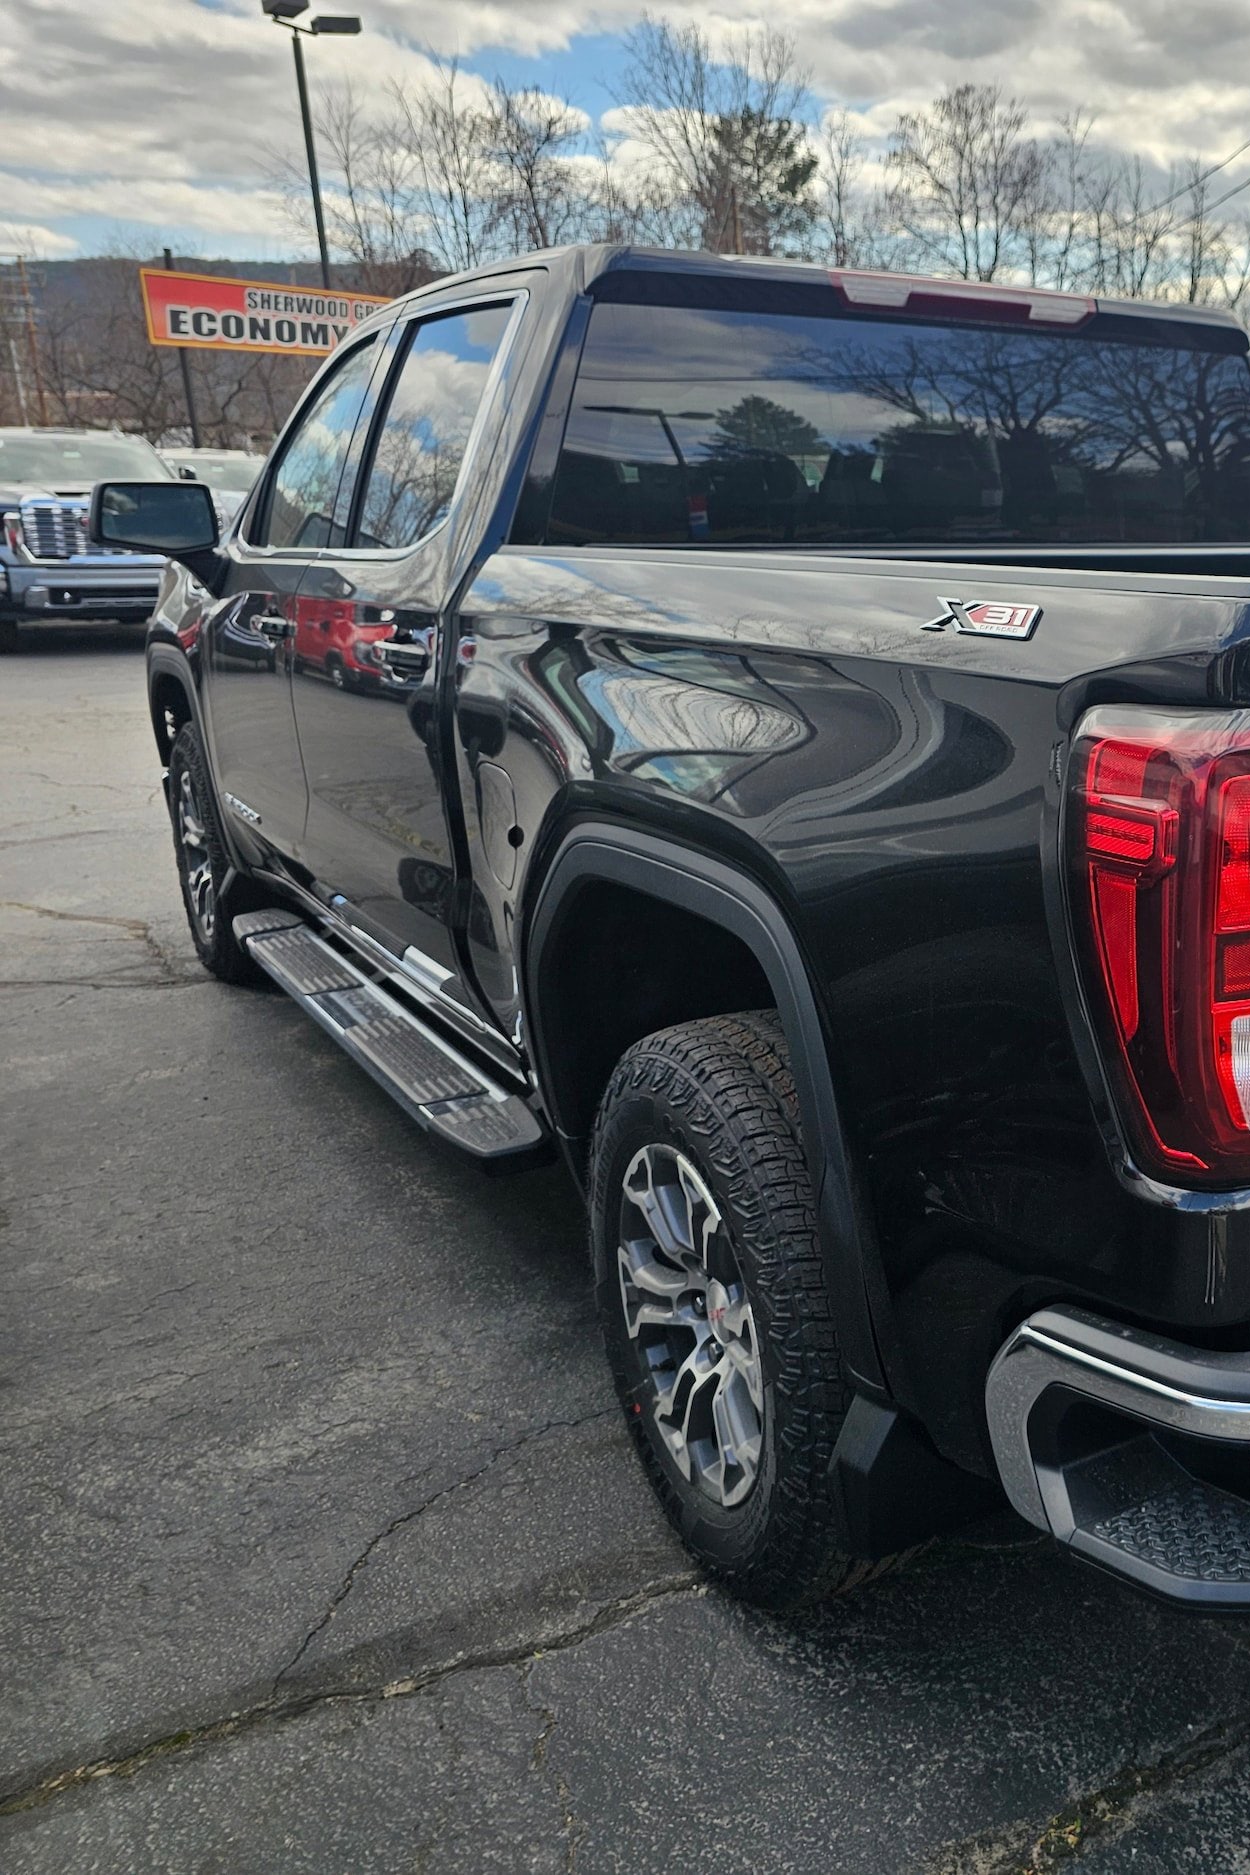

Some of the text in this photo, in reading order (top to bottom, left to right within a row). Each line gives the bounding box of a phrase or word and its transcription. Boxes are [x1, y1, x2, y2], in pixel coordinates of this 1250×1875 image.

[247, 291, 348, 317] SHERWOOD
[169, 309, 350, 346] ECONOMY
[920, 596, 1041, 639] X31
